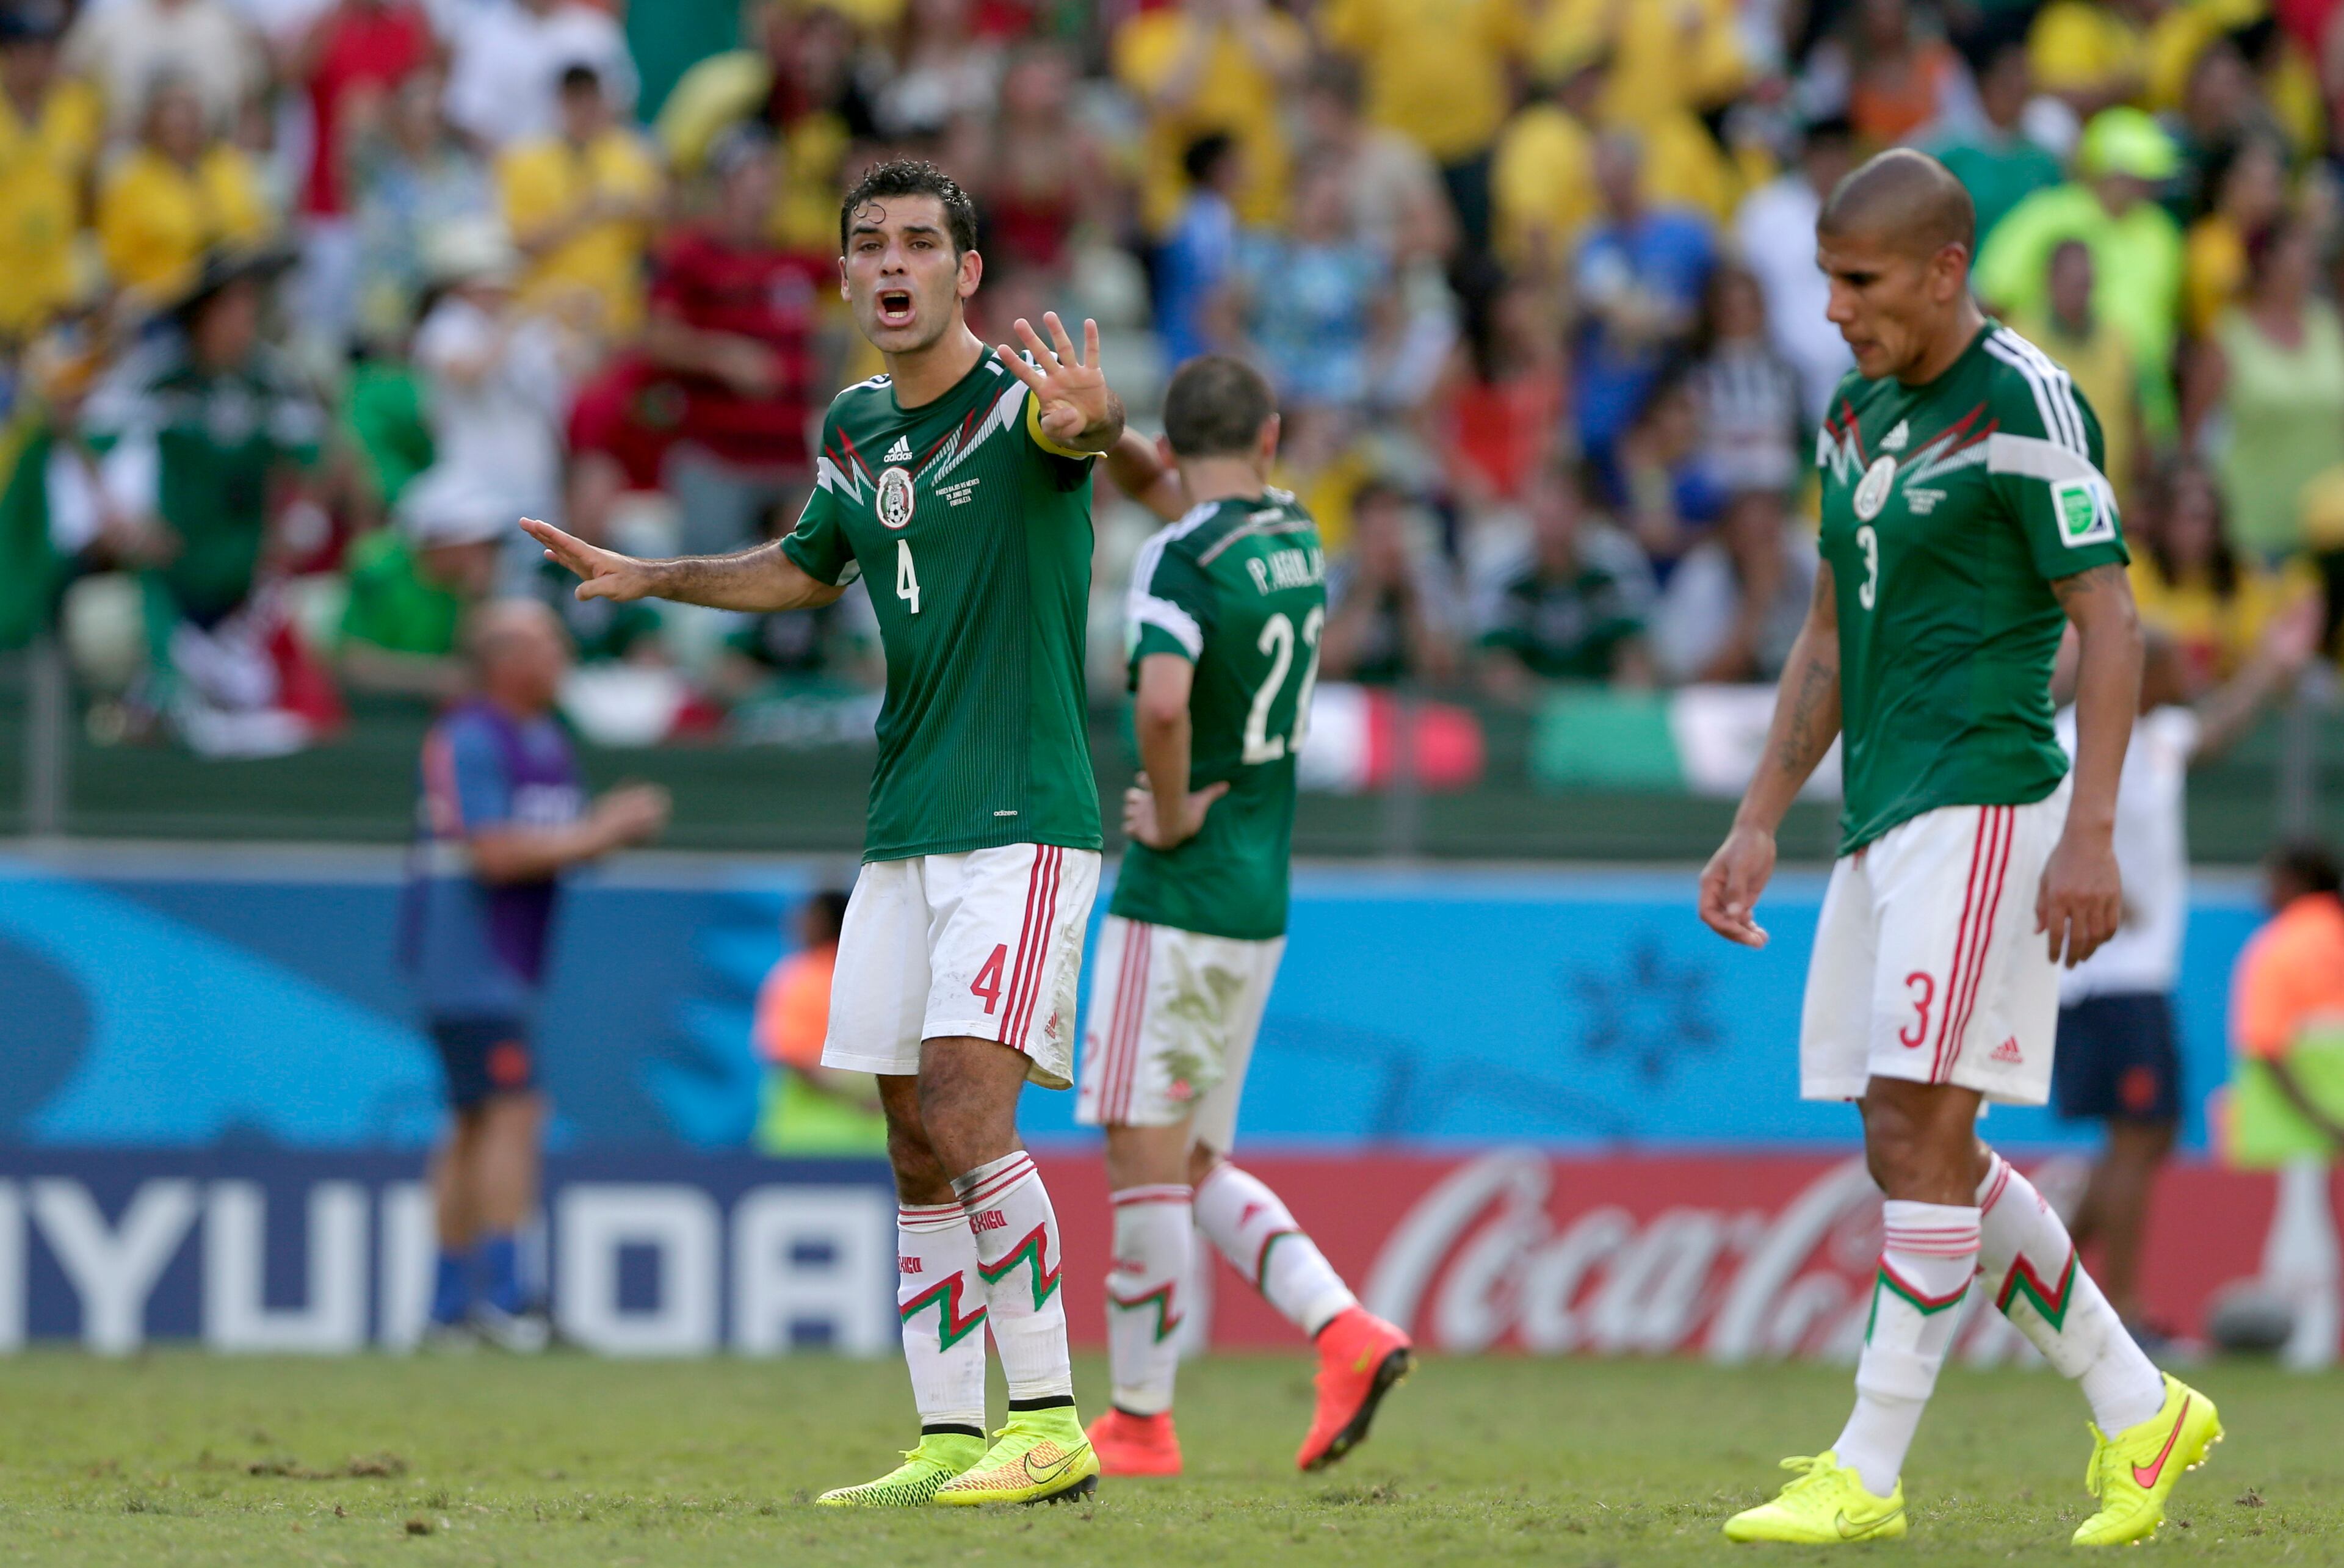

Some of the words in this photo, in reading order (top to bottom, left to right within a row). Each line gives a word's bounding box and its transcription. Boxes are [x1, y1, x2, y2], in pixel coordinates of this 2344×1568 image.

[884, 452, 913, 463] adidas
[950, 496, 972, 507] FORTALEZA
[897, 539, 920, 614] 4
[1856, 525, 1878, 610] 3
[970, 943, 1008, 1015] 4
[1899, 971, 1935, 1049] 3
[969, 1210, 1008, 1235] EXICO
[0, 1175, 901, 1356] YUDA
